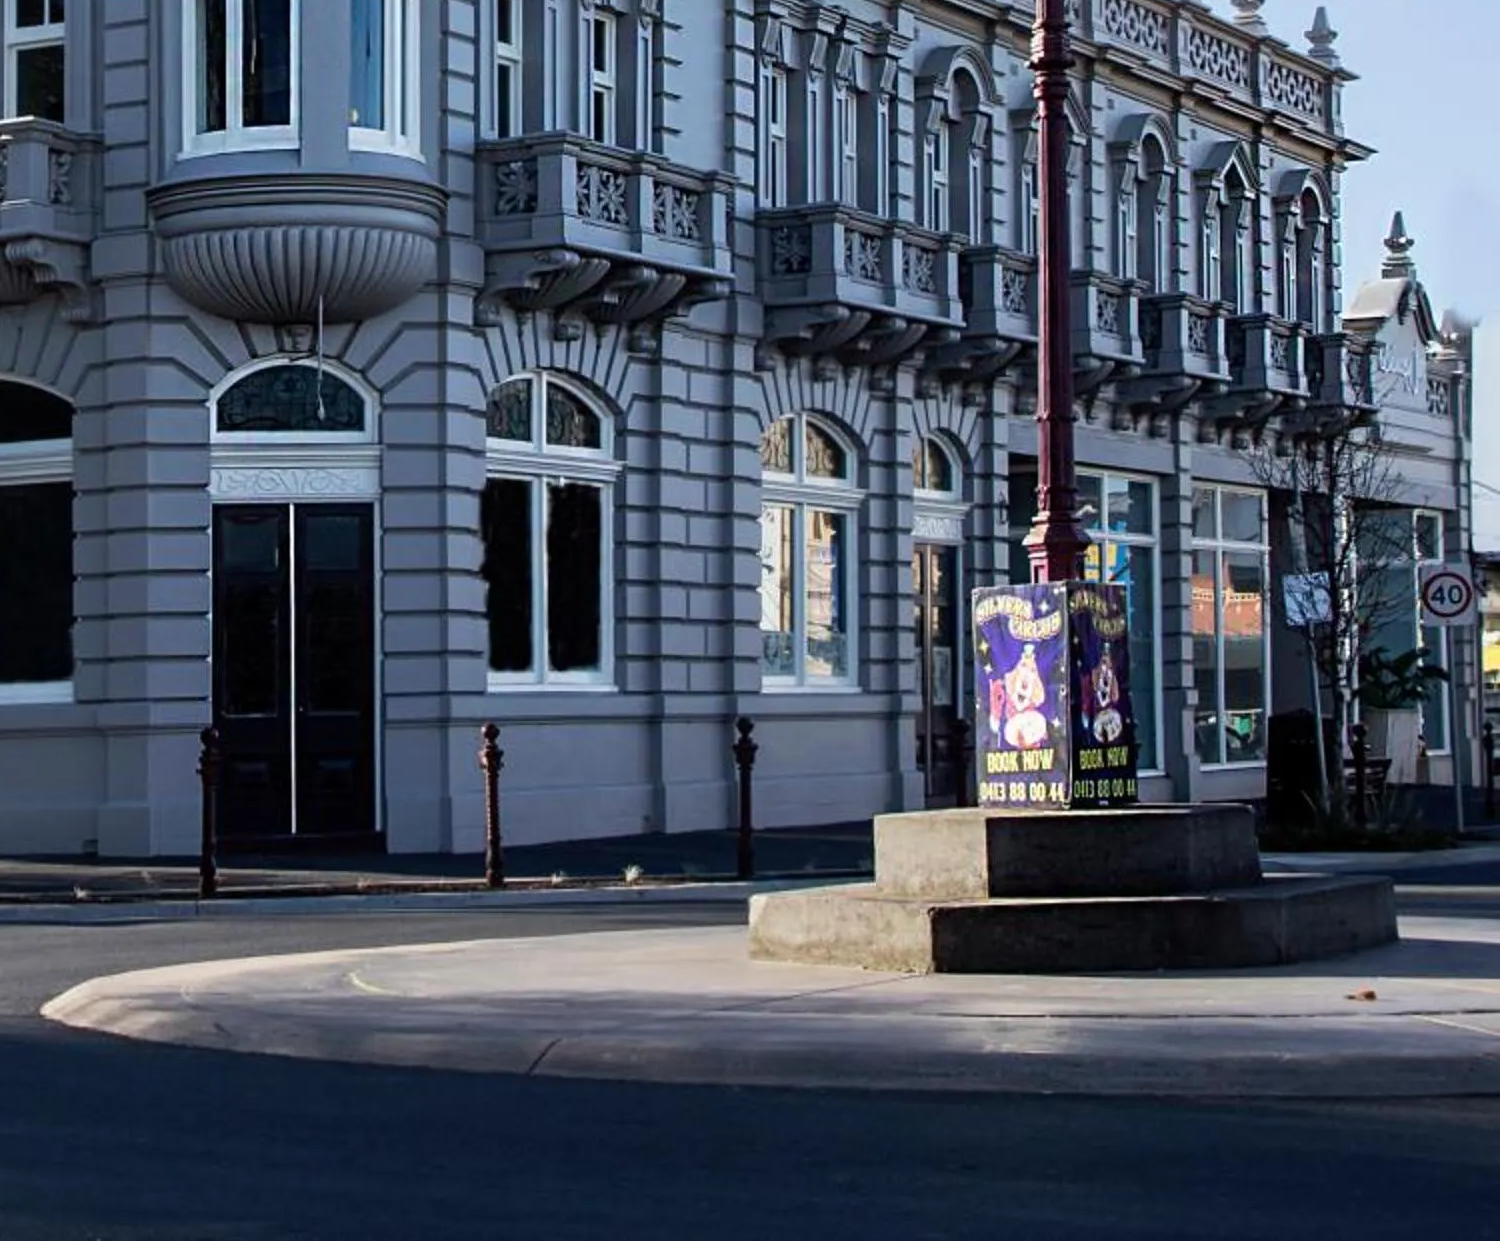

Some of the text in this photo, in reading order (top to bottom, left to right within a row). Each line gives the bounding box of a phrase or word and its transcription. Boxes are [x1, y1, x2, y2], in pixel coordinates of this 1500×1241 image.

[1431, 584, 1463, 605] 40
[987, 748, 1054, 773] BOOK NOW
[1079, 745, 1129, 770] BOOK NOW
[980, 782, 1065, 802] 0413 88 00 44
[1073, 779, 1136, 798] 0413 88 00 44
